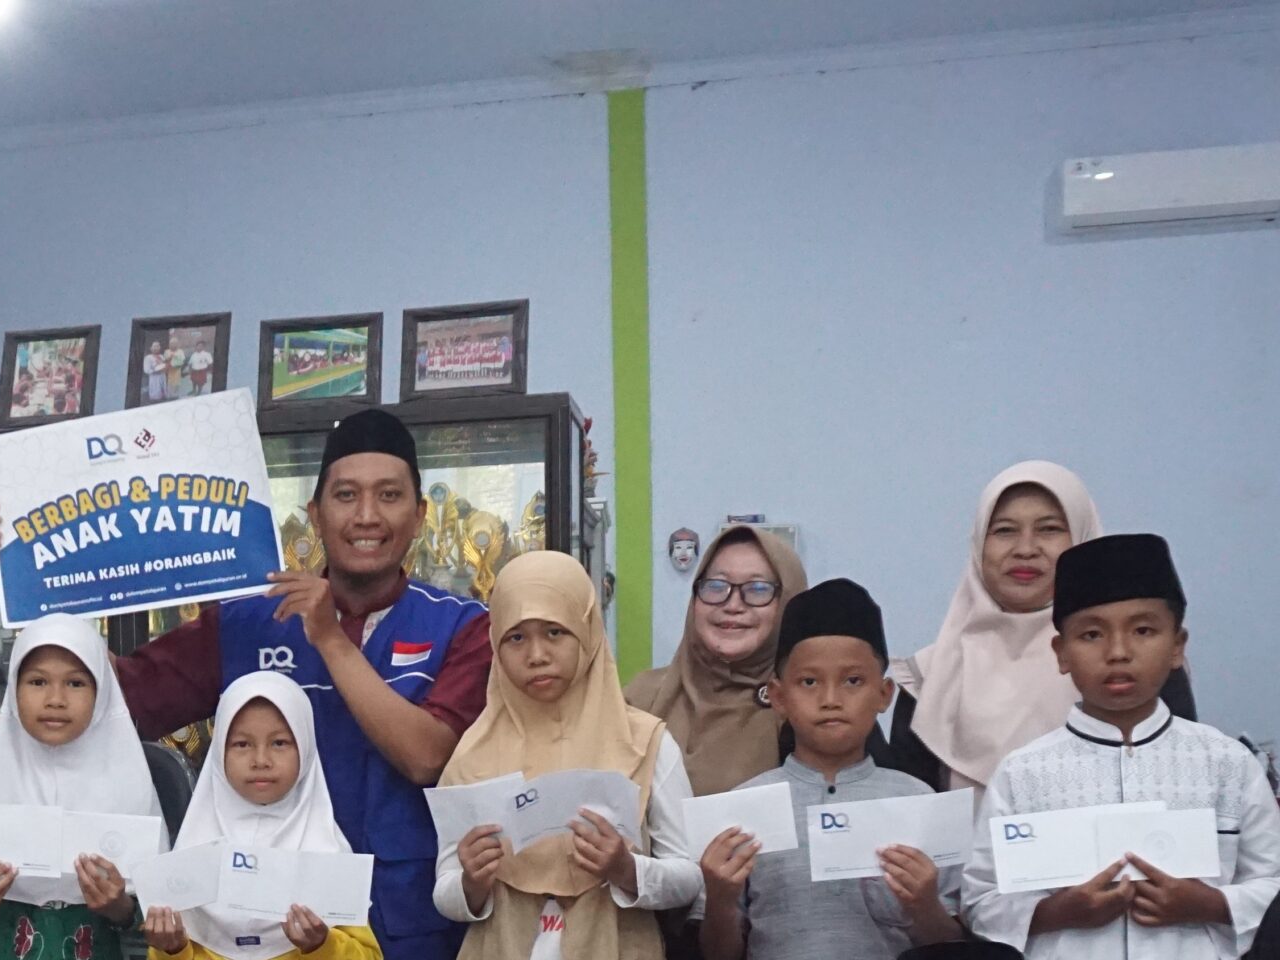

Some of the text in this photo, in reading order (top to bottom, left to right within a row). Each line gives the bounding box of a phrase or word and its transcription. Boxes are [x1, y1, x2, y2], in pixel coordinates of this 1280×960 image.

[14, 474, 249, 543] BERBAGI & PEDULI
[32, 505, 241, 570] ANAK YATIM
[44, 548, 236, 589] TERIMA KASIH #ORANGBAIK
[258, 646, 298, 669] DQ
